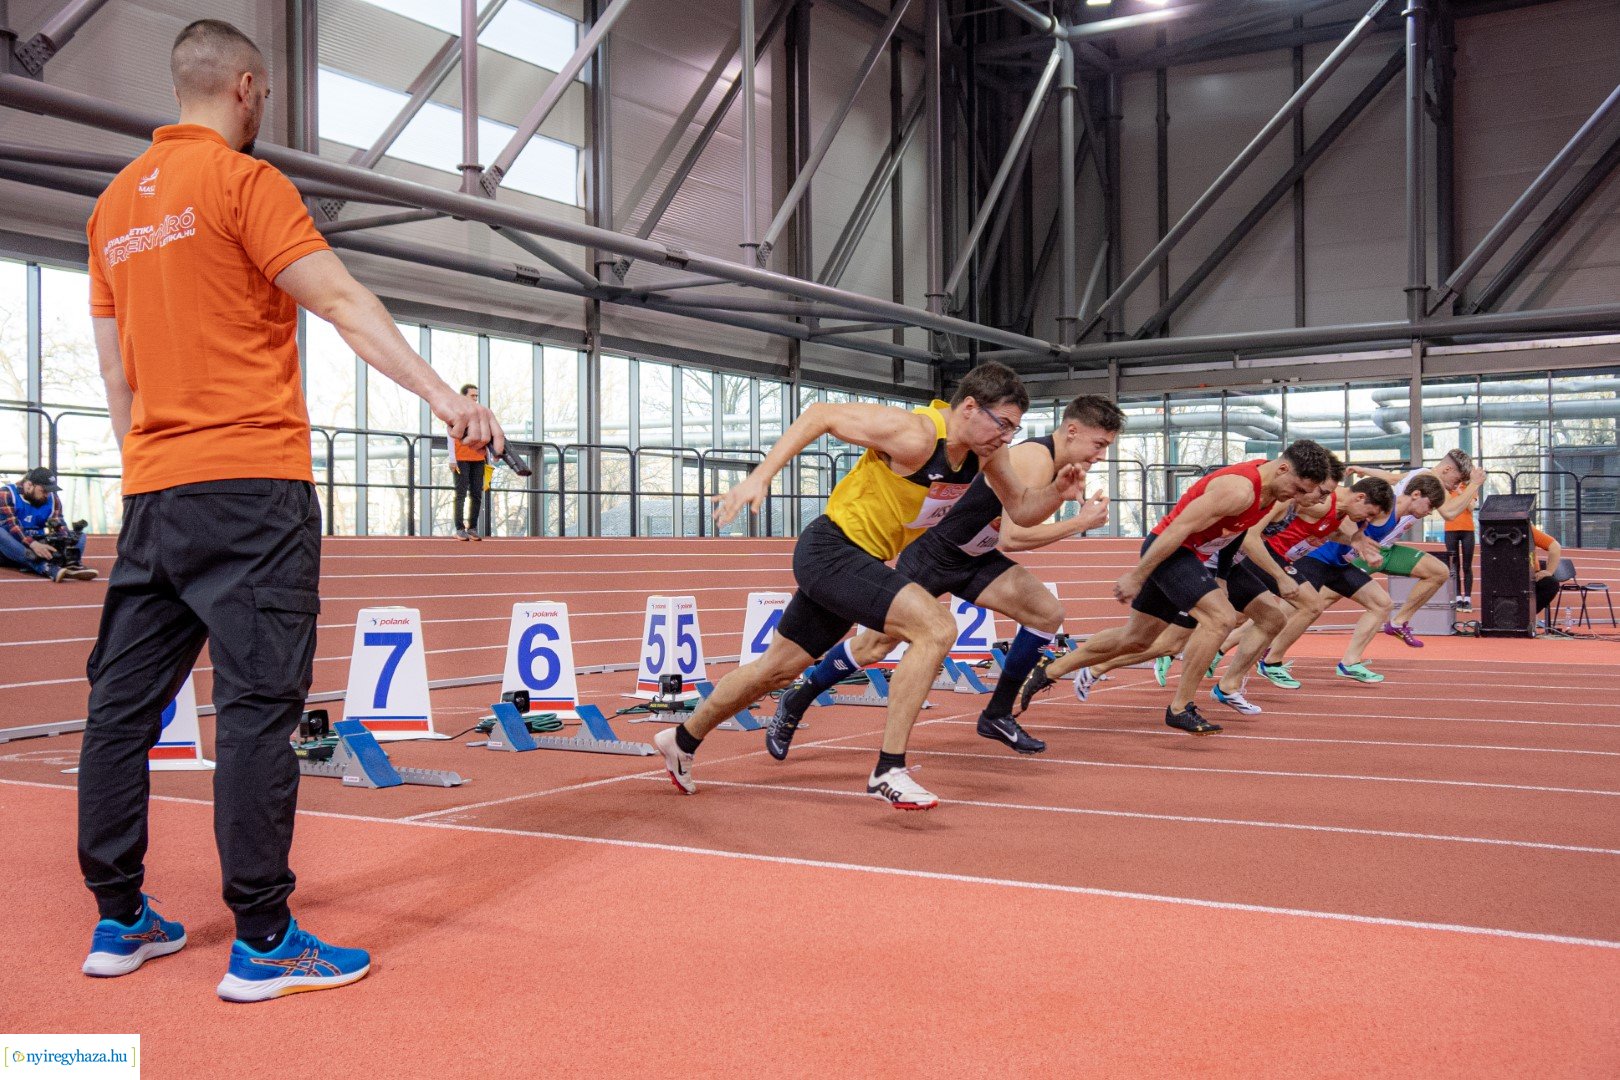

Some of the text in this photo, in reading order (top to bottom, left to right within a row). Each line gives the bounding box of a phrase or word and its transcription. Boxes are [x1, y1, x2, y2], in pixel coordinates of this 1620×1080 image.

[379, 617, 410, 627] polanik
[531, 610, 559, 619] polanik
[956, 601, 988, 646] 2
[517, 622, 561, 691] 6
[645, 613, 667, 675] 5
[676, 613, 698, 674] 5
[363, 632, 413, 709] 7
[879, 781, 903, 803] AIR
